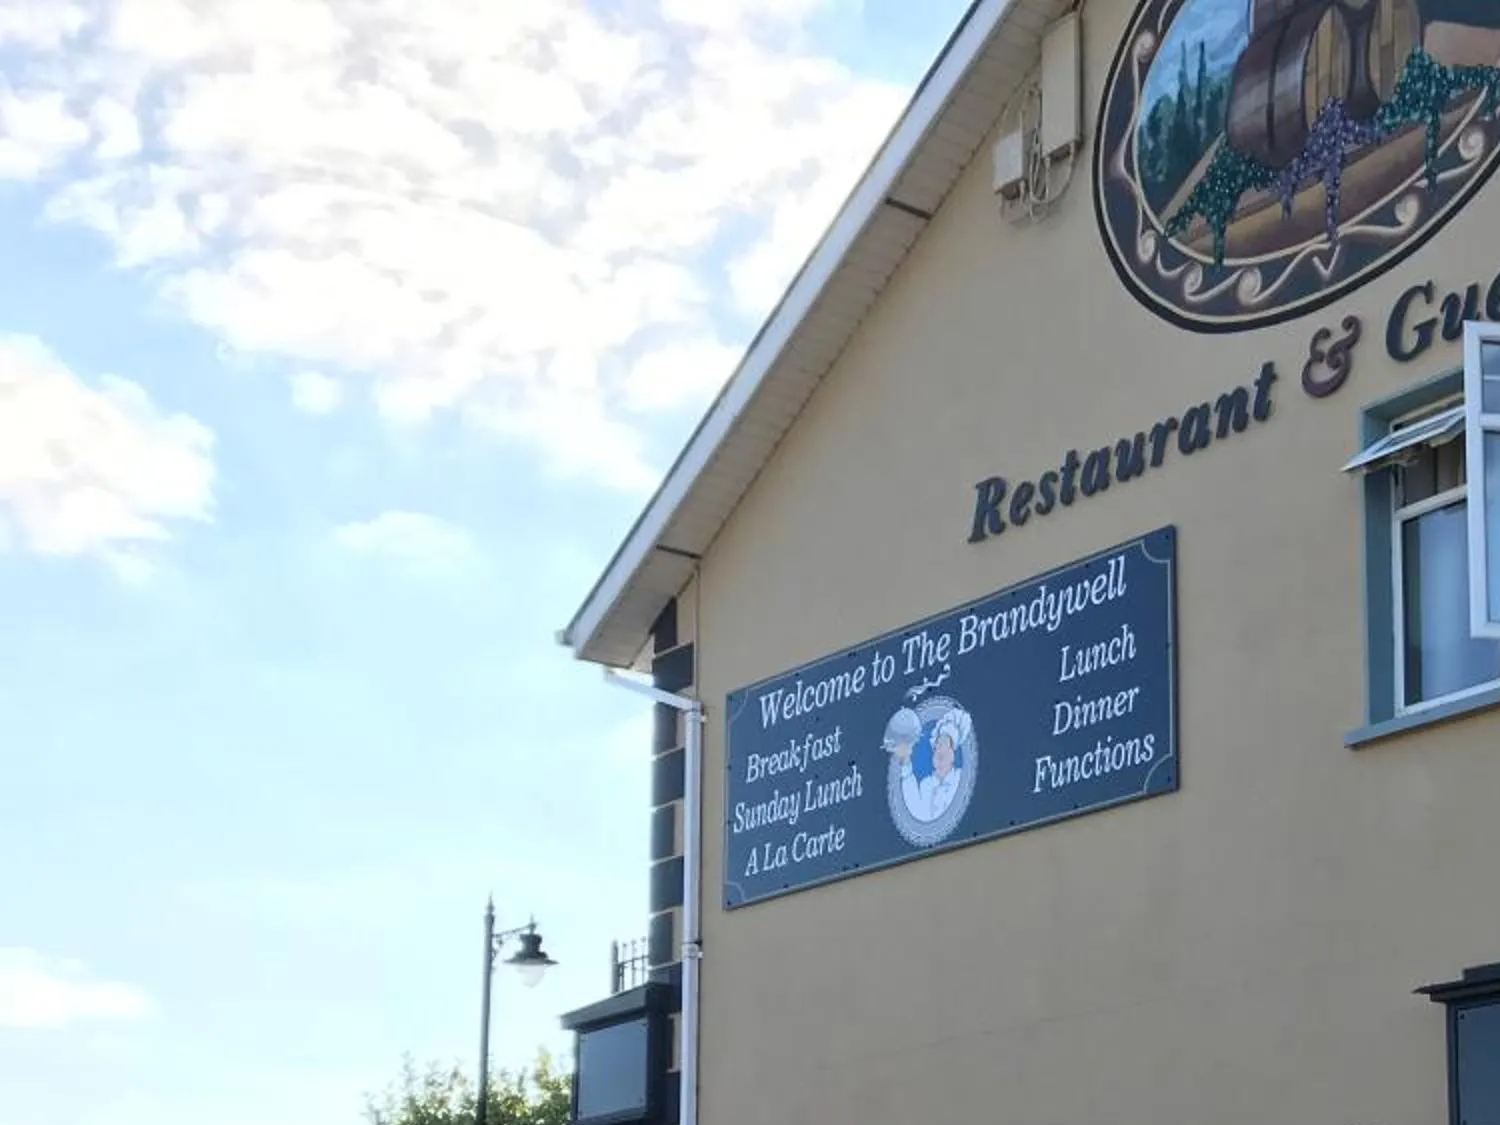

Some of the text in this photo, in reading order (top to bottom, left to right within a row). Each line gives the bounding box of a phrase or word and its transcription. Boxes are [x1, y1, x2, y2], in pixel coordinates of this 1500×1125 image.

[967, 361, 1278, 544] Restaurant
[1301, 315, 1361, 398] &
[759, 556, 1127, 728] Welcome to The Brandywell
[1060, 624, 1136, 682] Lunch
[1052, 685, 1140, 736] Dinner
[746, 726, 842, 784] Breakfast
[1032, 733, 1154, 793] Functions
[733, 770, 863, 833] Sunday Lunch
[744, 825, 845, 876] A La Carte
